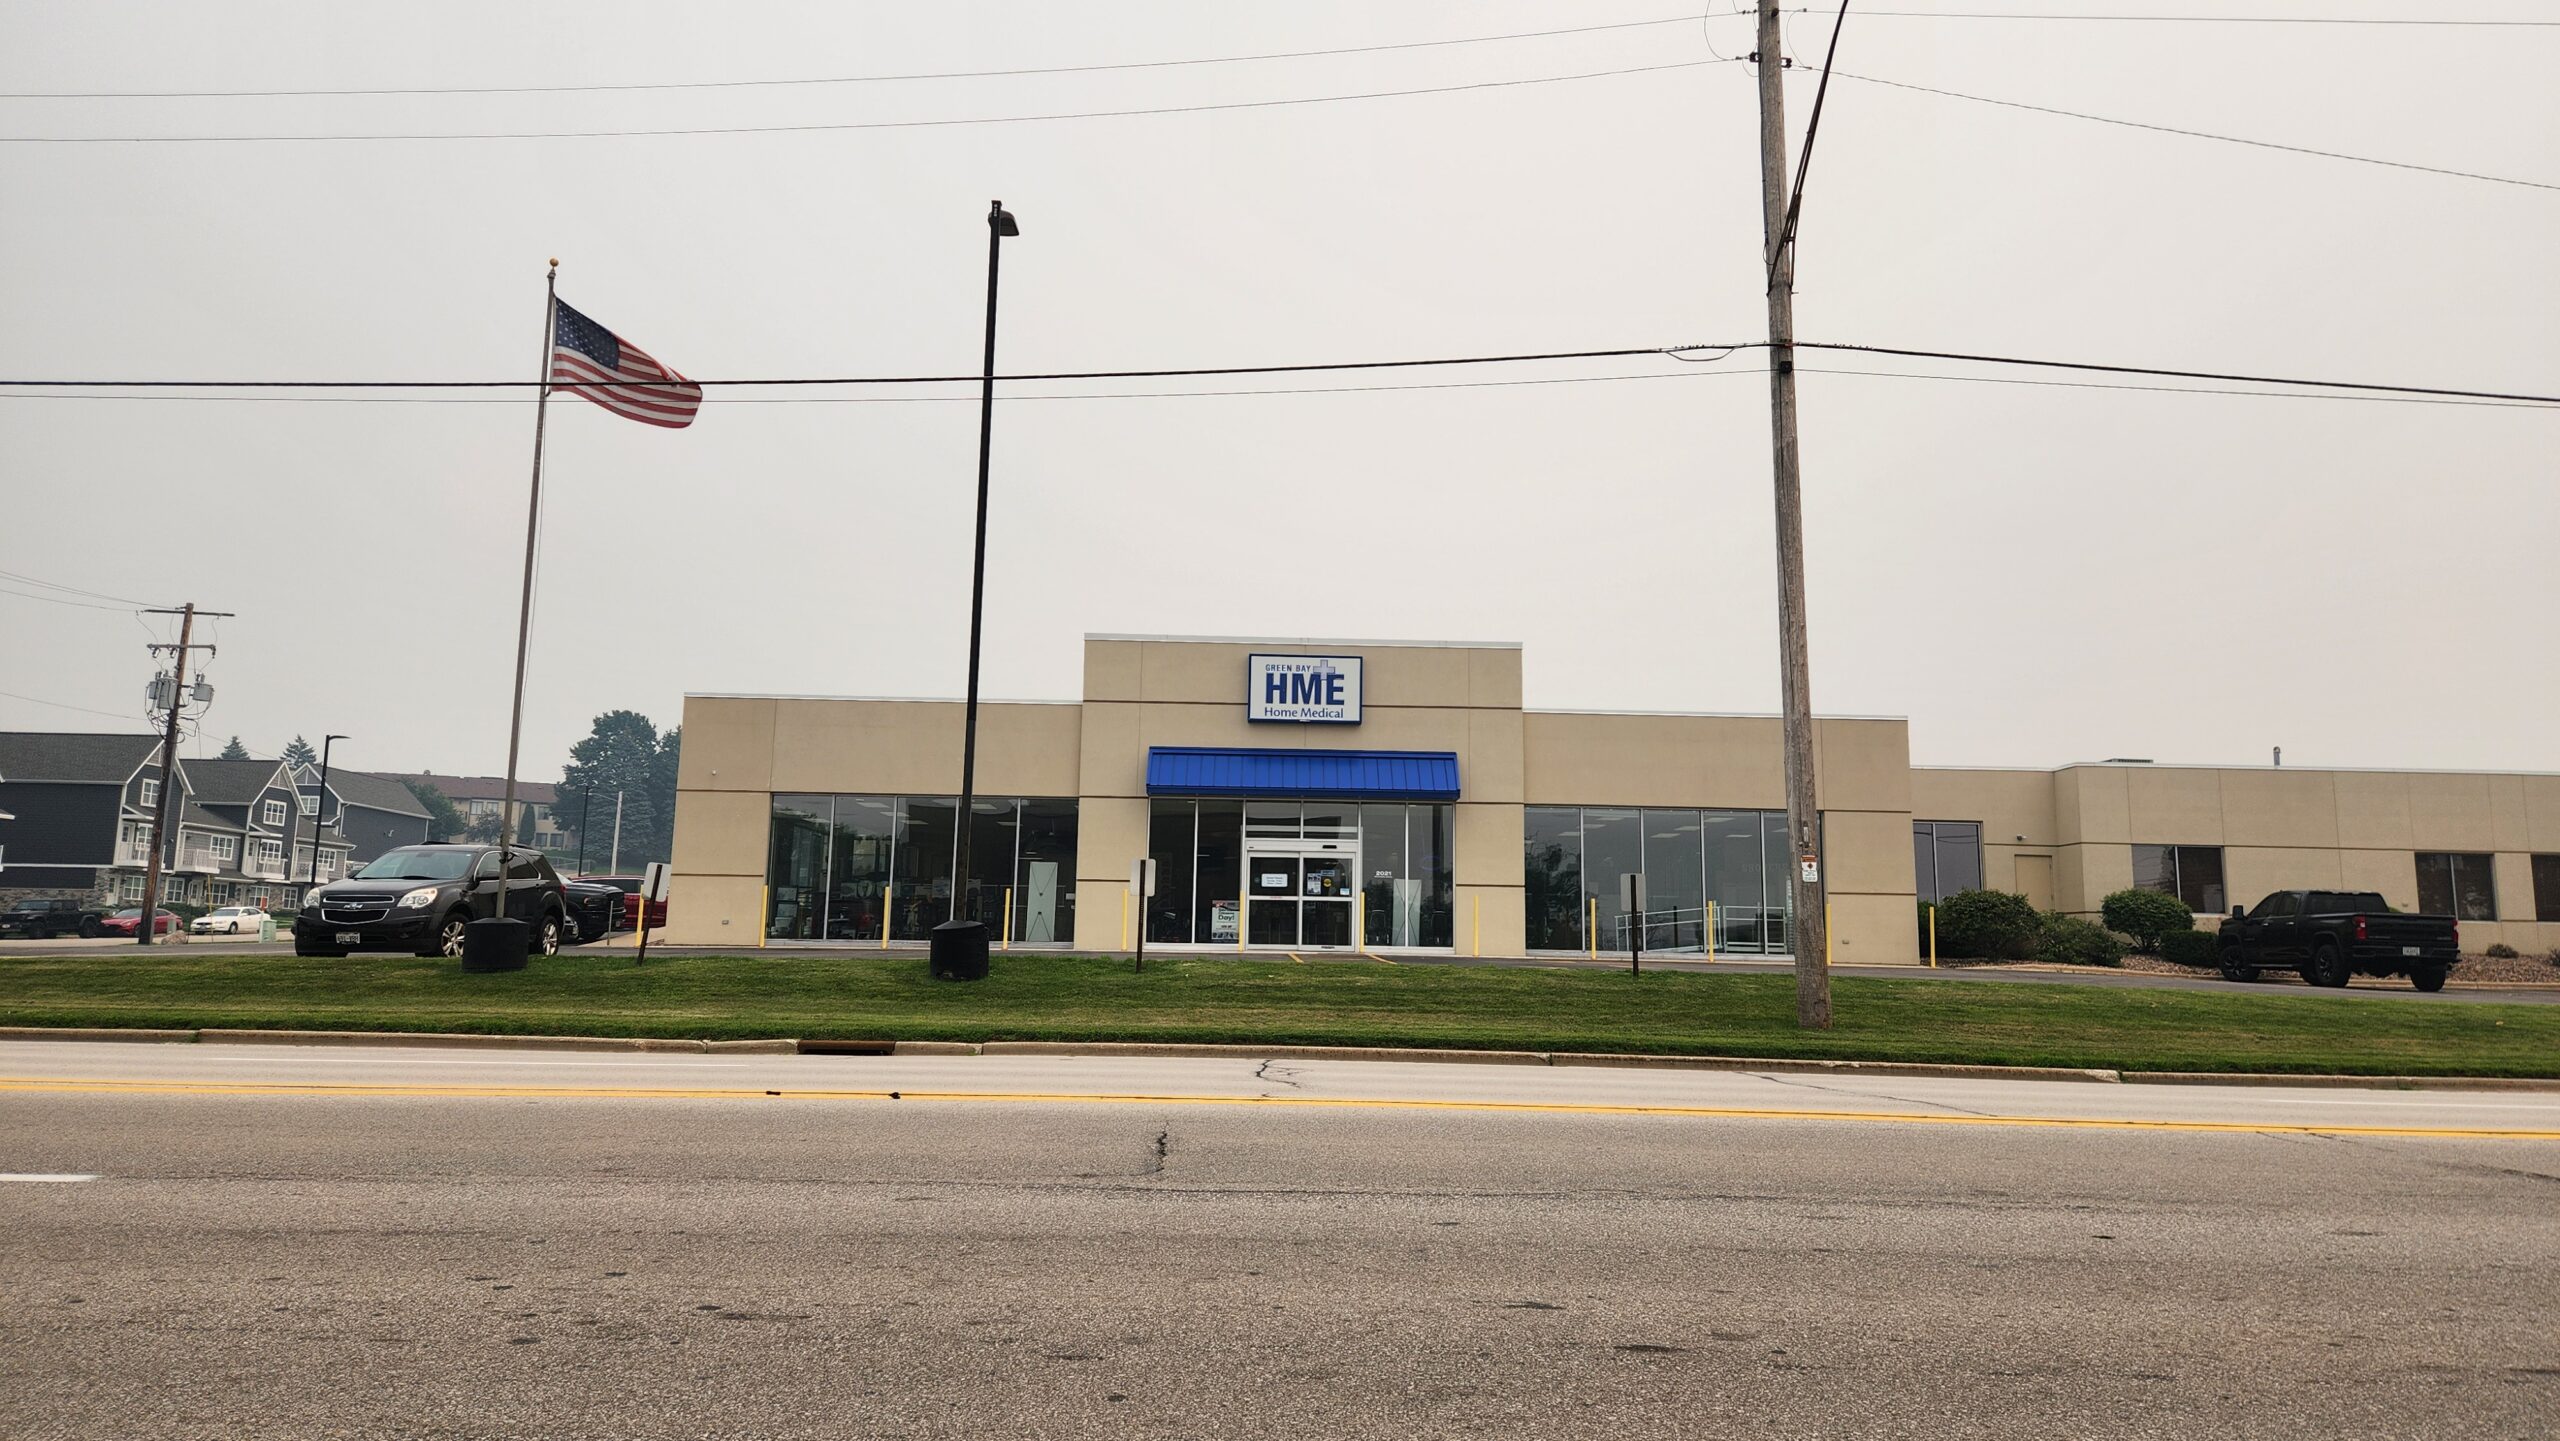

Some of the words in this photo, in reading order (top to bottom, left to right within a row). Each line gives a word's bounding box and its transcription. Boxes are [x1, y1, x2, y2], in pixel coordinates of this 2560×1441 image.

[1265, 664, 1292, 672] GREEN
[1265, 673, 1345, 705] HME
[1264, 707, 1298, 717] Home
[1300, 707, 1344, 718] Medical
